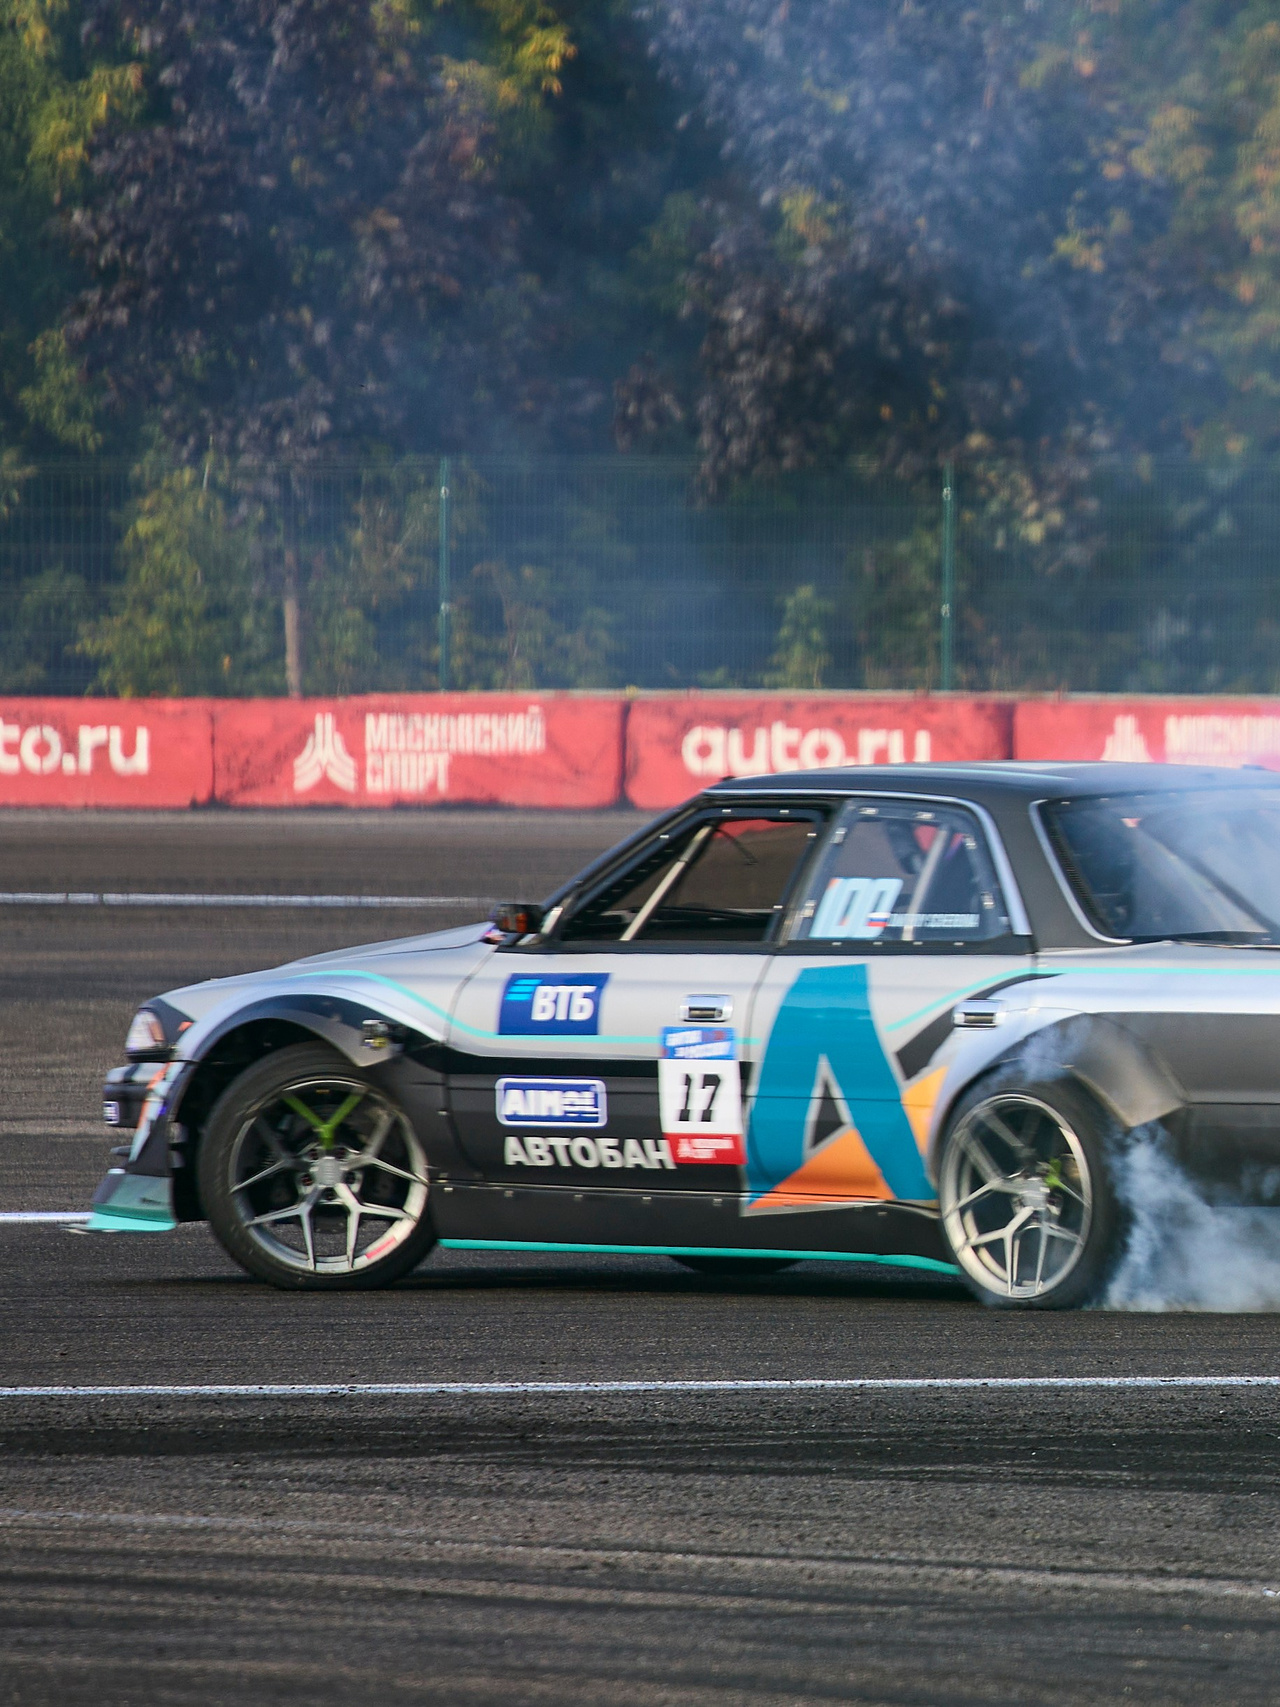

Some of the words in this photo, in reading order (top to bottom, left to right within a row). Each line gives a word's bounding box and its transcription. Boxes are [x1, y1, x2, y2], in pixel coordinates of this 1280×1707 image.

[365, 751, 450, 794] СПОРТ
[531, 985, 597, 1022] ВТБ
[676, 1073, 721, 1122] 17
[504, 1135, 678, 1170] АВТОБАН
